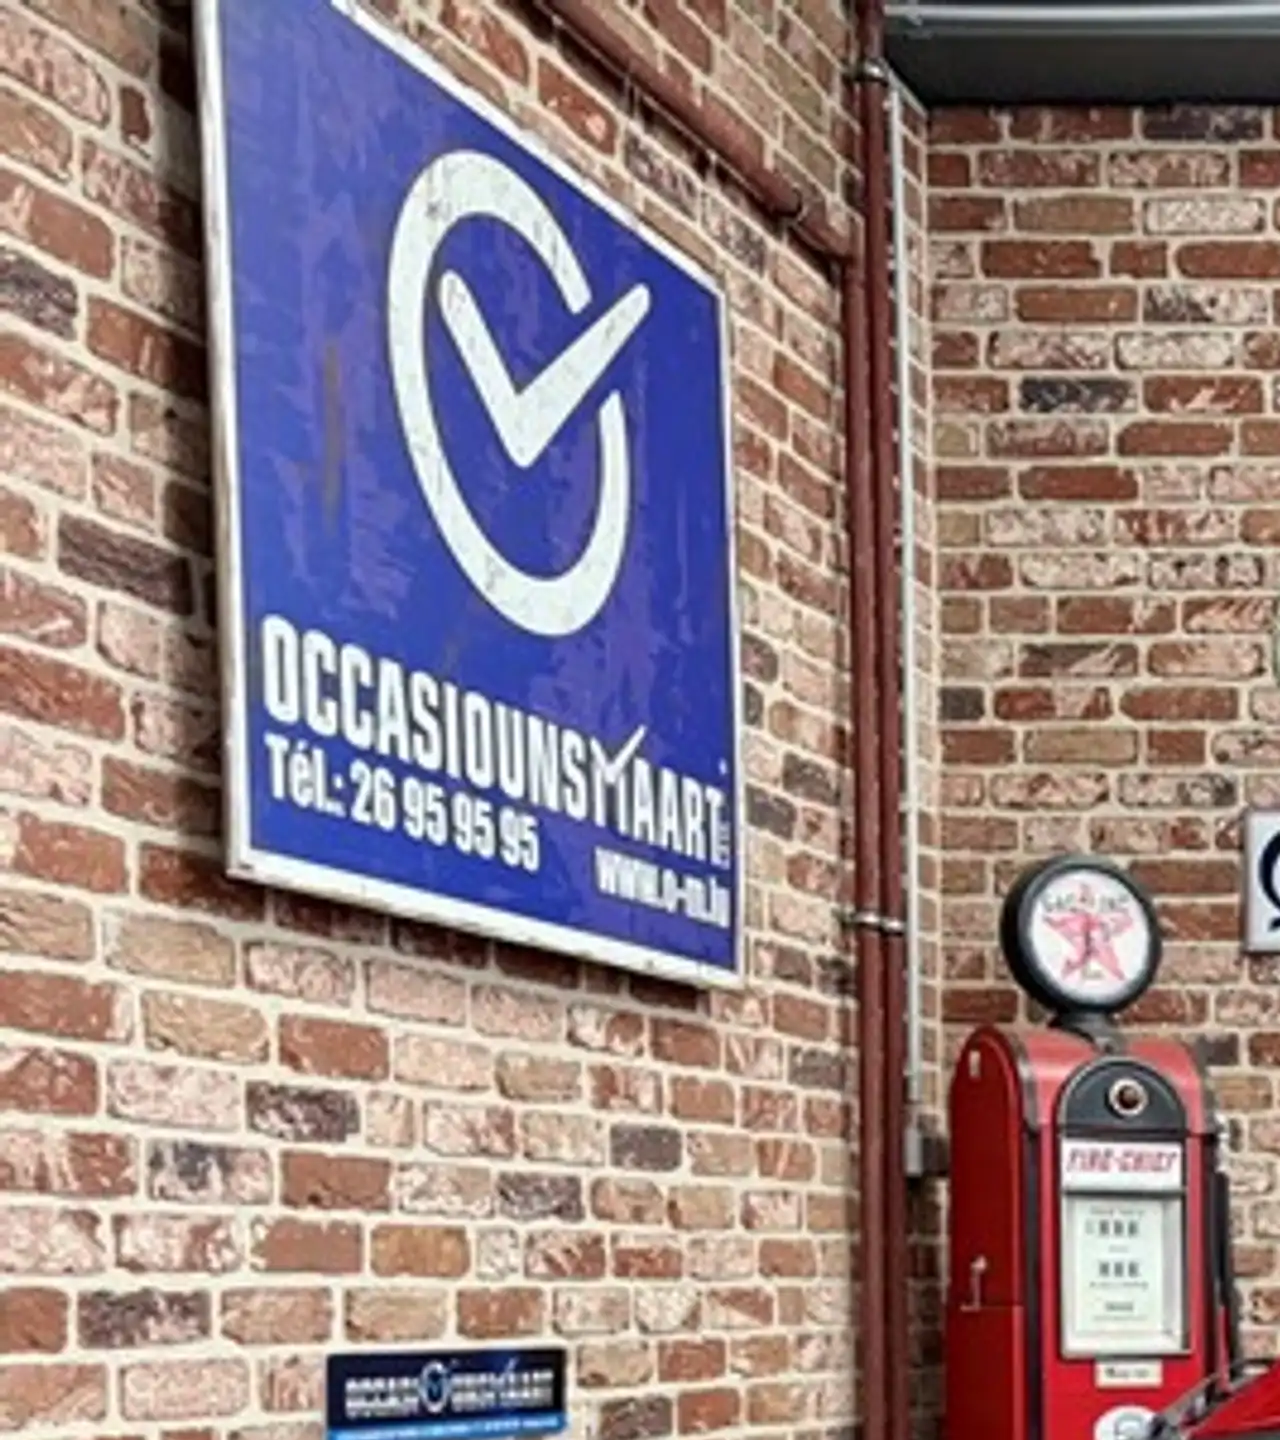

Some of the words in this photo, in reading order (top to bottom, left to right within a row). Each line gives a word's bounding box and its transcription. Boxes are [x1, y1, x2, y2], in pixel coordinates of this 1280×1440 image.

[351, 760, 397, 832] 26
[403, 778, 448, 847] 95
[452, 791, 496, 860] 95
[500, 806, 540, 873] 95
